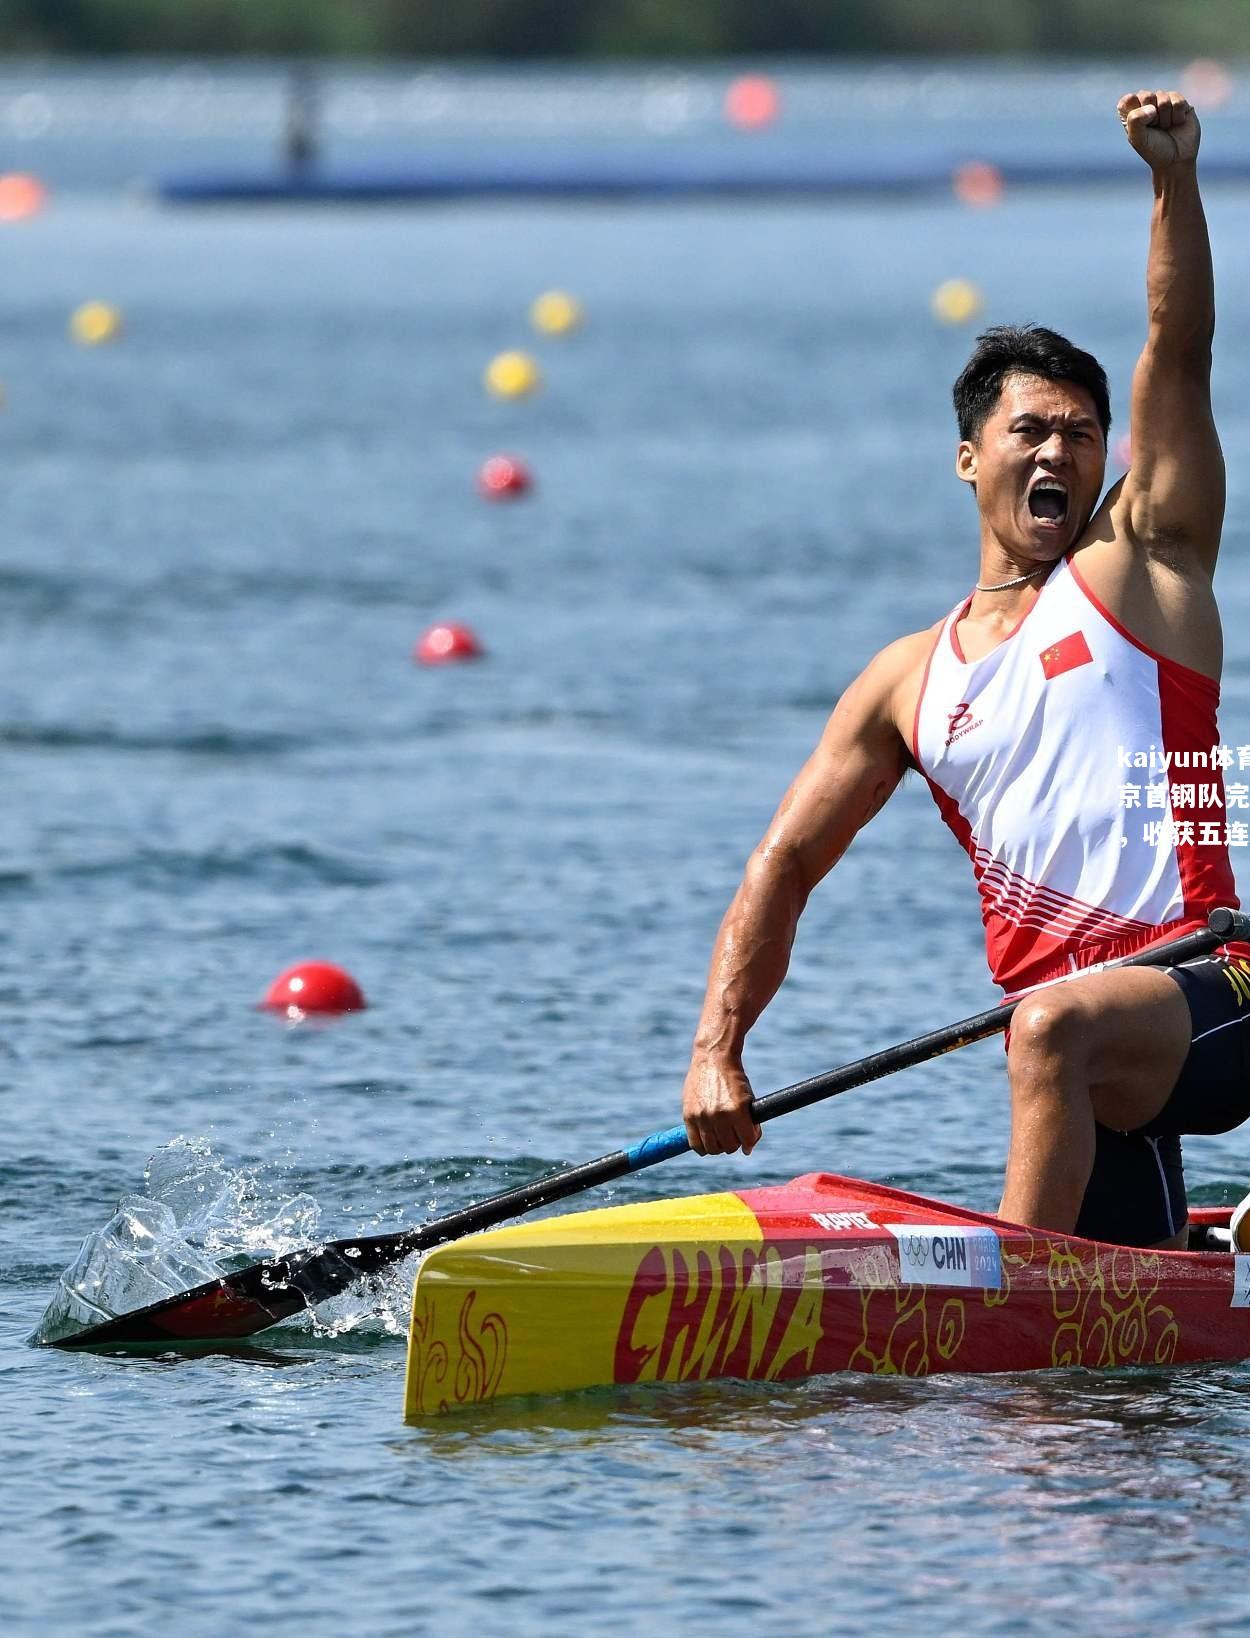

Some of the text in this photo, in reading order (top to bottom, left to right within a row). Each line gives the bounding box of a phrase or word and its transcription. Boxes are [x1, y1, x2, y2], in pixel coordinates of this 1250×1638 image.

[932, 1236, 967, 1271] CHN
[974, 1255, 998, 1273] 2024
[613, 1245, 824, 1384] CHINA
